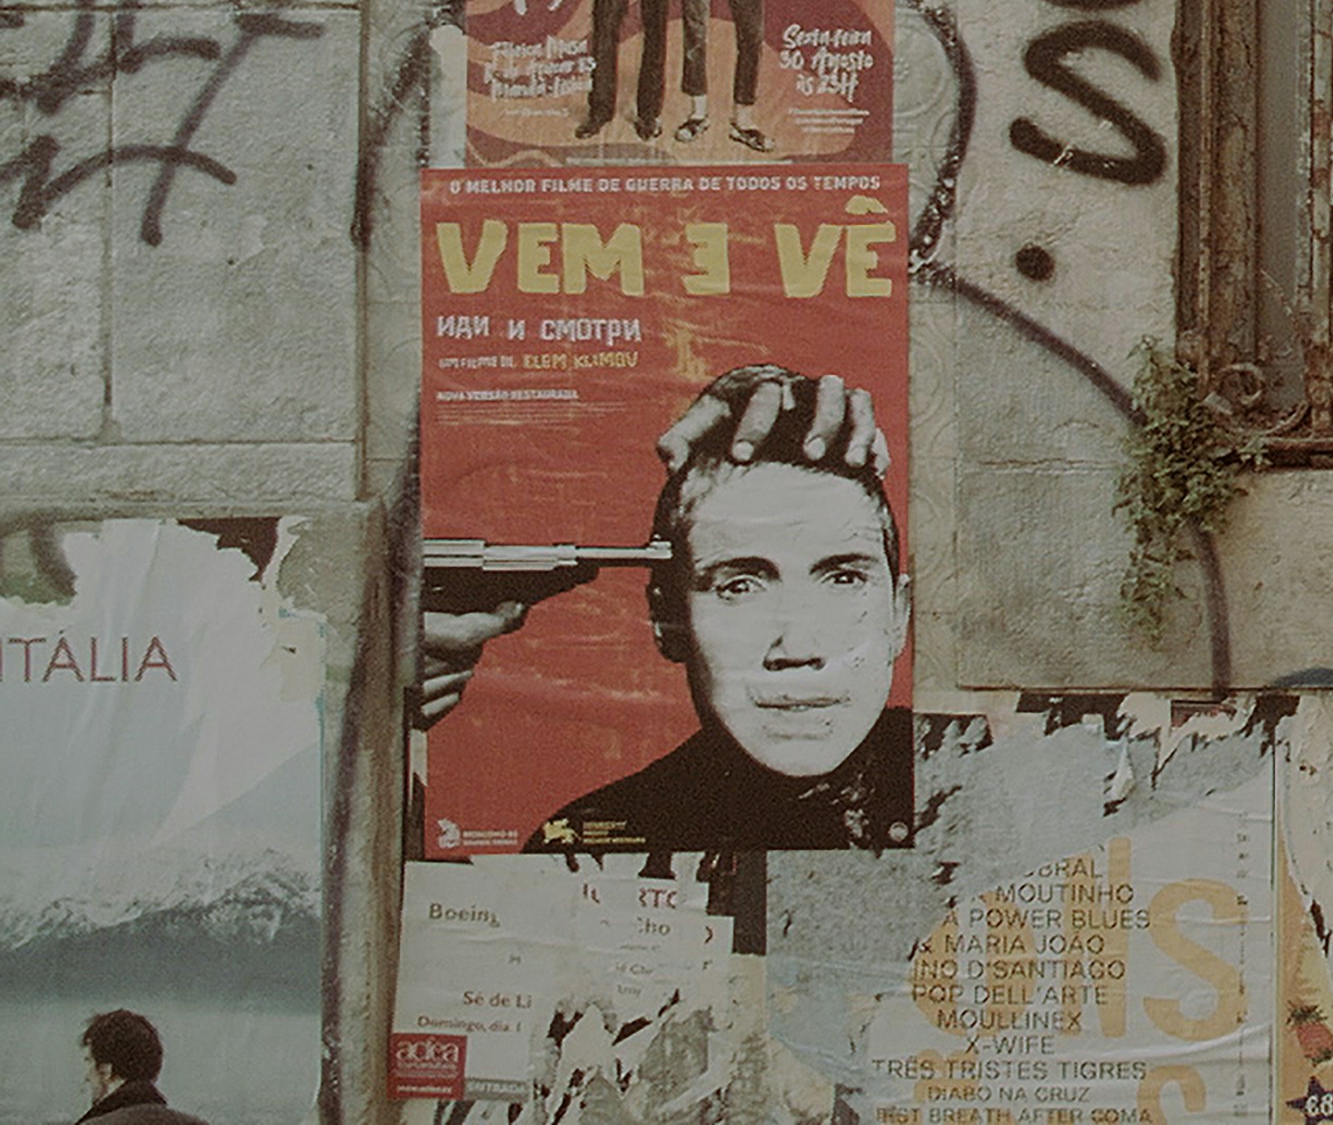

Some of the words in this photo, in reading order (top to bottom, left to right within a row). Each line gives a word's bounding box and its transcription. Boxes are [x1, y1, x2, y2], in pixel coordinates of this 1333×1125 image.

[449, 179, 462, 196] O
[465, 178, 538, 195] MELHOR
[541, 177, 593, 194] FILME
[599, 177, 619, 193] DE
[625, 176, 695, 193] GUERRA
[699, 176, 720, 192] DE
[726, 176, 781, 192] TODOS
[786, 176, 807, 192] OS
[812, 175, 882, 191] TEMPOS
[435, 219, 645, 297] VEM
[774, 195, 897, 298] VÊ
[436, 315, 490, 340] ИДИ
[507, 319, 526, 341] И
[539, 317, 643, 347] СМОТРИ
[1023, 857, 1104, 878] BRAL
[995, 883, 1134, 905] MOUTINHO
[969, 909, 1063, 929] POWER
[1071, 909, 1152, 930] BLUES
[944, 934, 1026, 955] MARIA
[1034, 931, 1106, 955] JOÃO
[967, 958, 1127, 980] D'SANTIAGO
[489, 992, 511, 1008] de
[912, 983, 964, 1006] POP
[973, 983, 1109, 1006] DELL'ARTE
[935, 1008, 1083, 1030] MOULLINEX
[964, 1034, 1056, 1056] X-WIFE
[871, 1057, 935, 1080] TRÊS
[944, 1060, 1049, 1080] TRISTES
[1057, 1060, 1148, 1080] TIGRES
[927, 1085, 992, 1104] DIABO
[998, 1086, 1027, 1104] NA
[1033, 1085, 1092, 1104] CRUZ
[928, 1107, 1011, 1125] BREATH
[1017, 1107, 1084, 1125] AFTER
[1089, 1107, 1154, 1125] COMA
